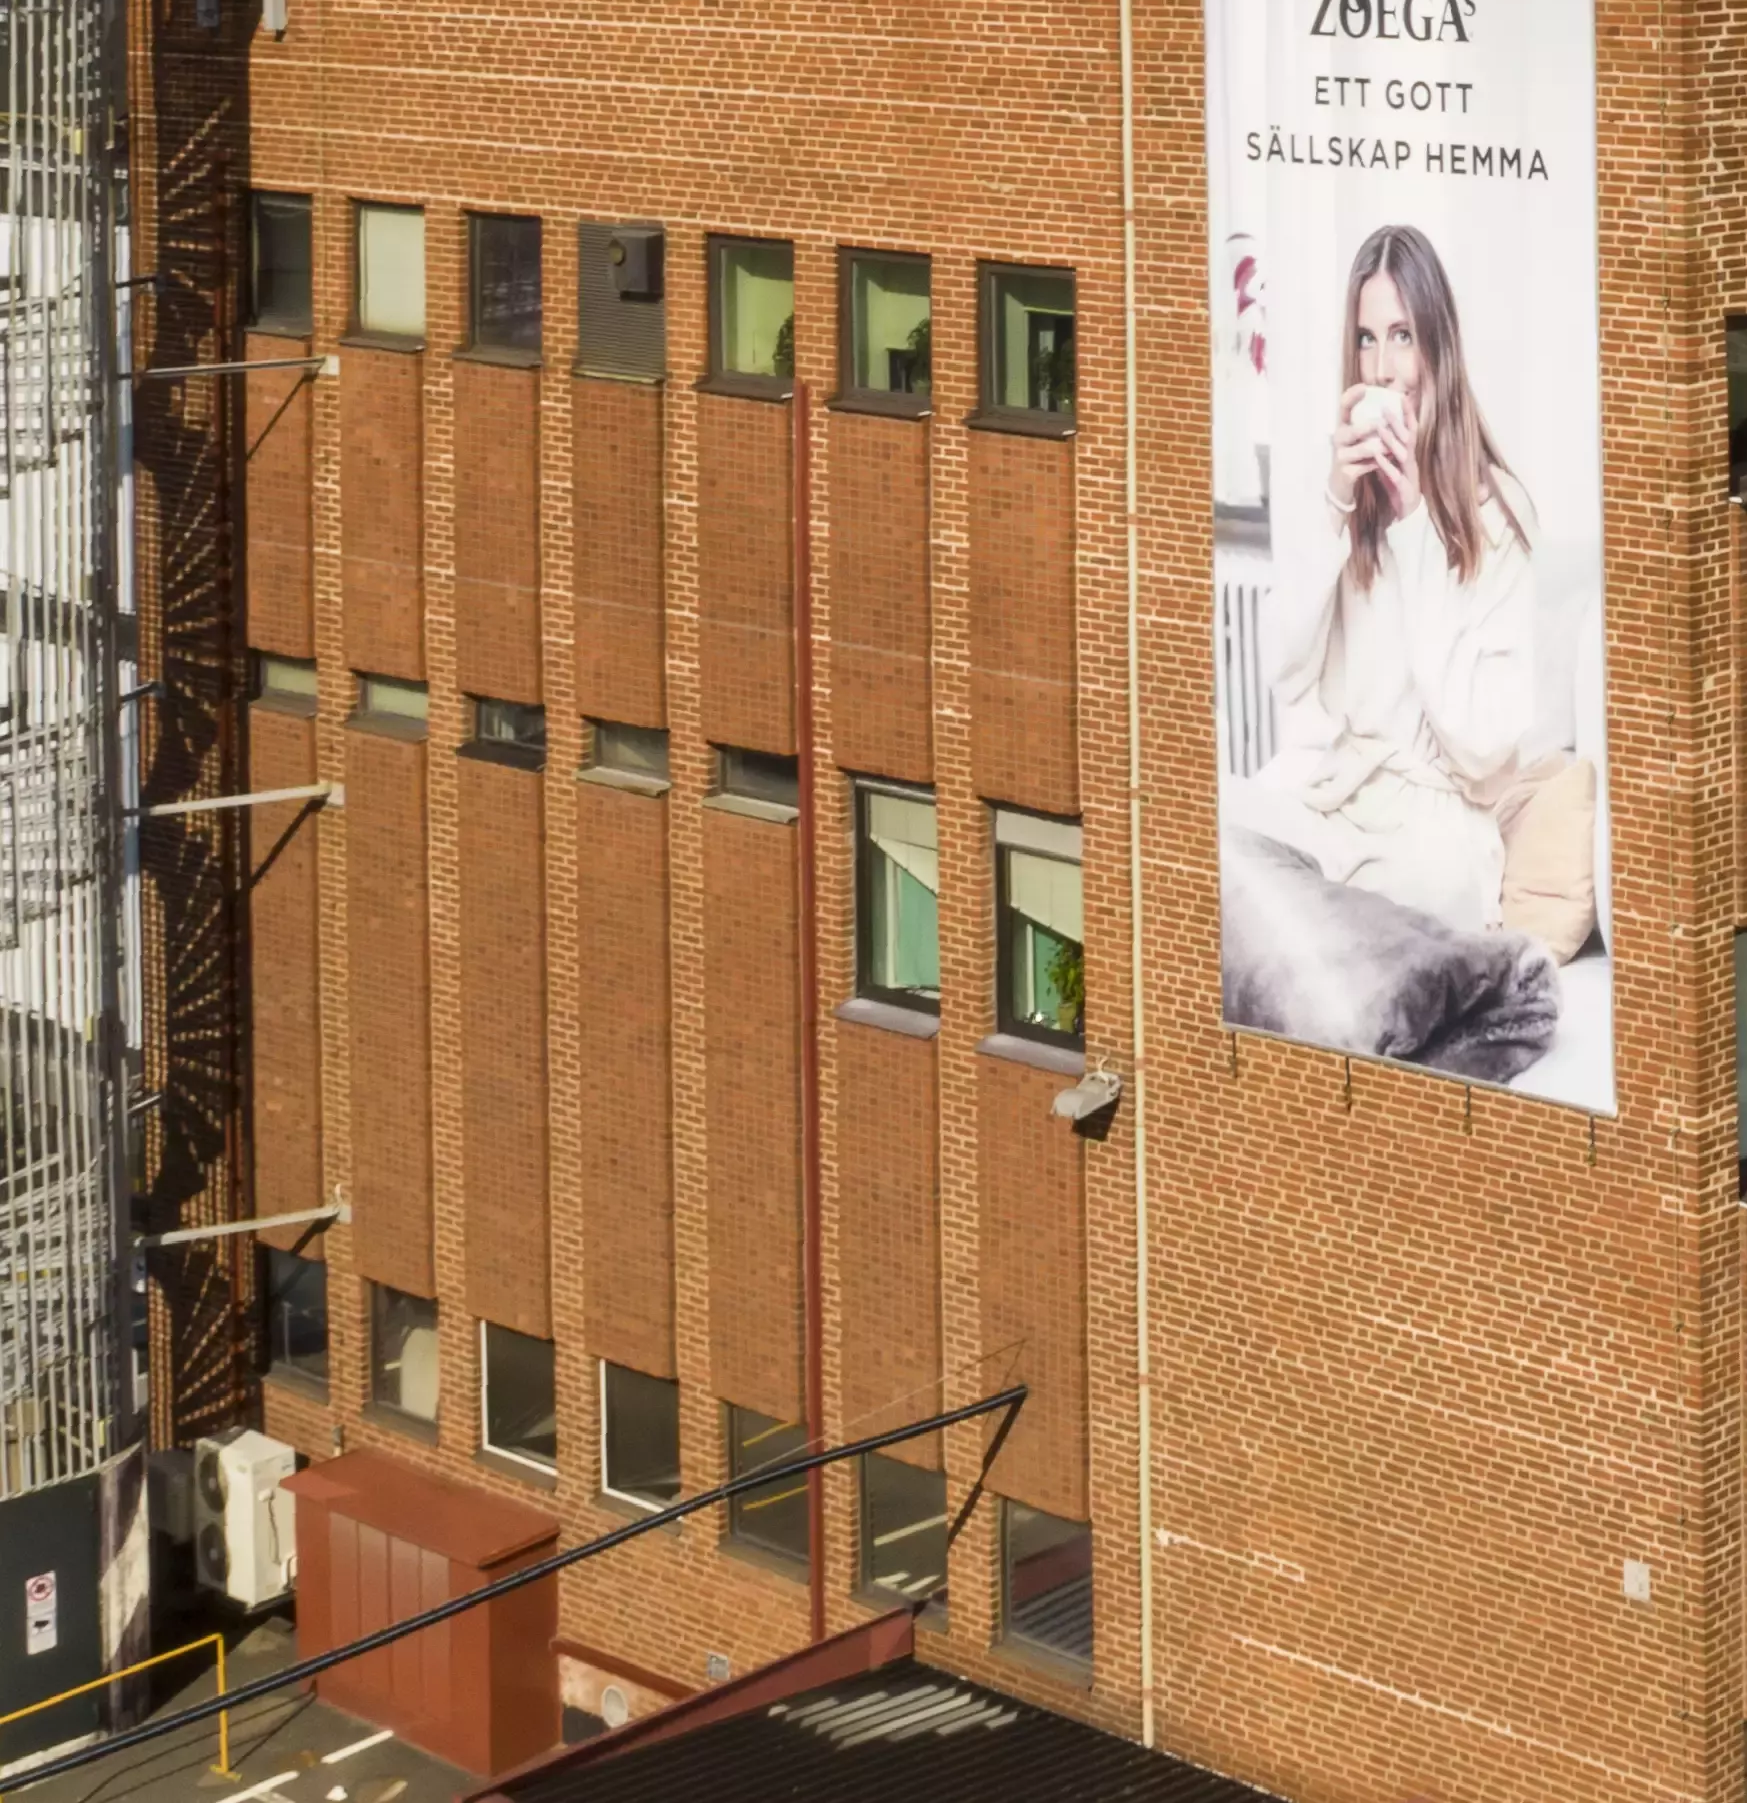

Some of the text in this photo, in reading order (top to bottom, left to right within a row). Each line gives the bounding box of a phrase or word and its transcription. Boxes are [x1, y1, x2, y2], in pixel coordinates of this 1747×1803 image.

[1314, 76, 1473, 113] ETT GOTT
[1246, 125, 1549, 180] SÄLLSKAP HEMMA
